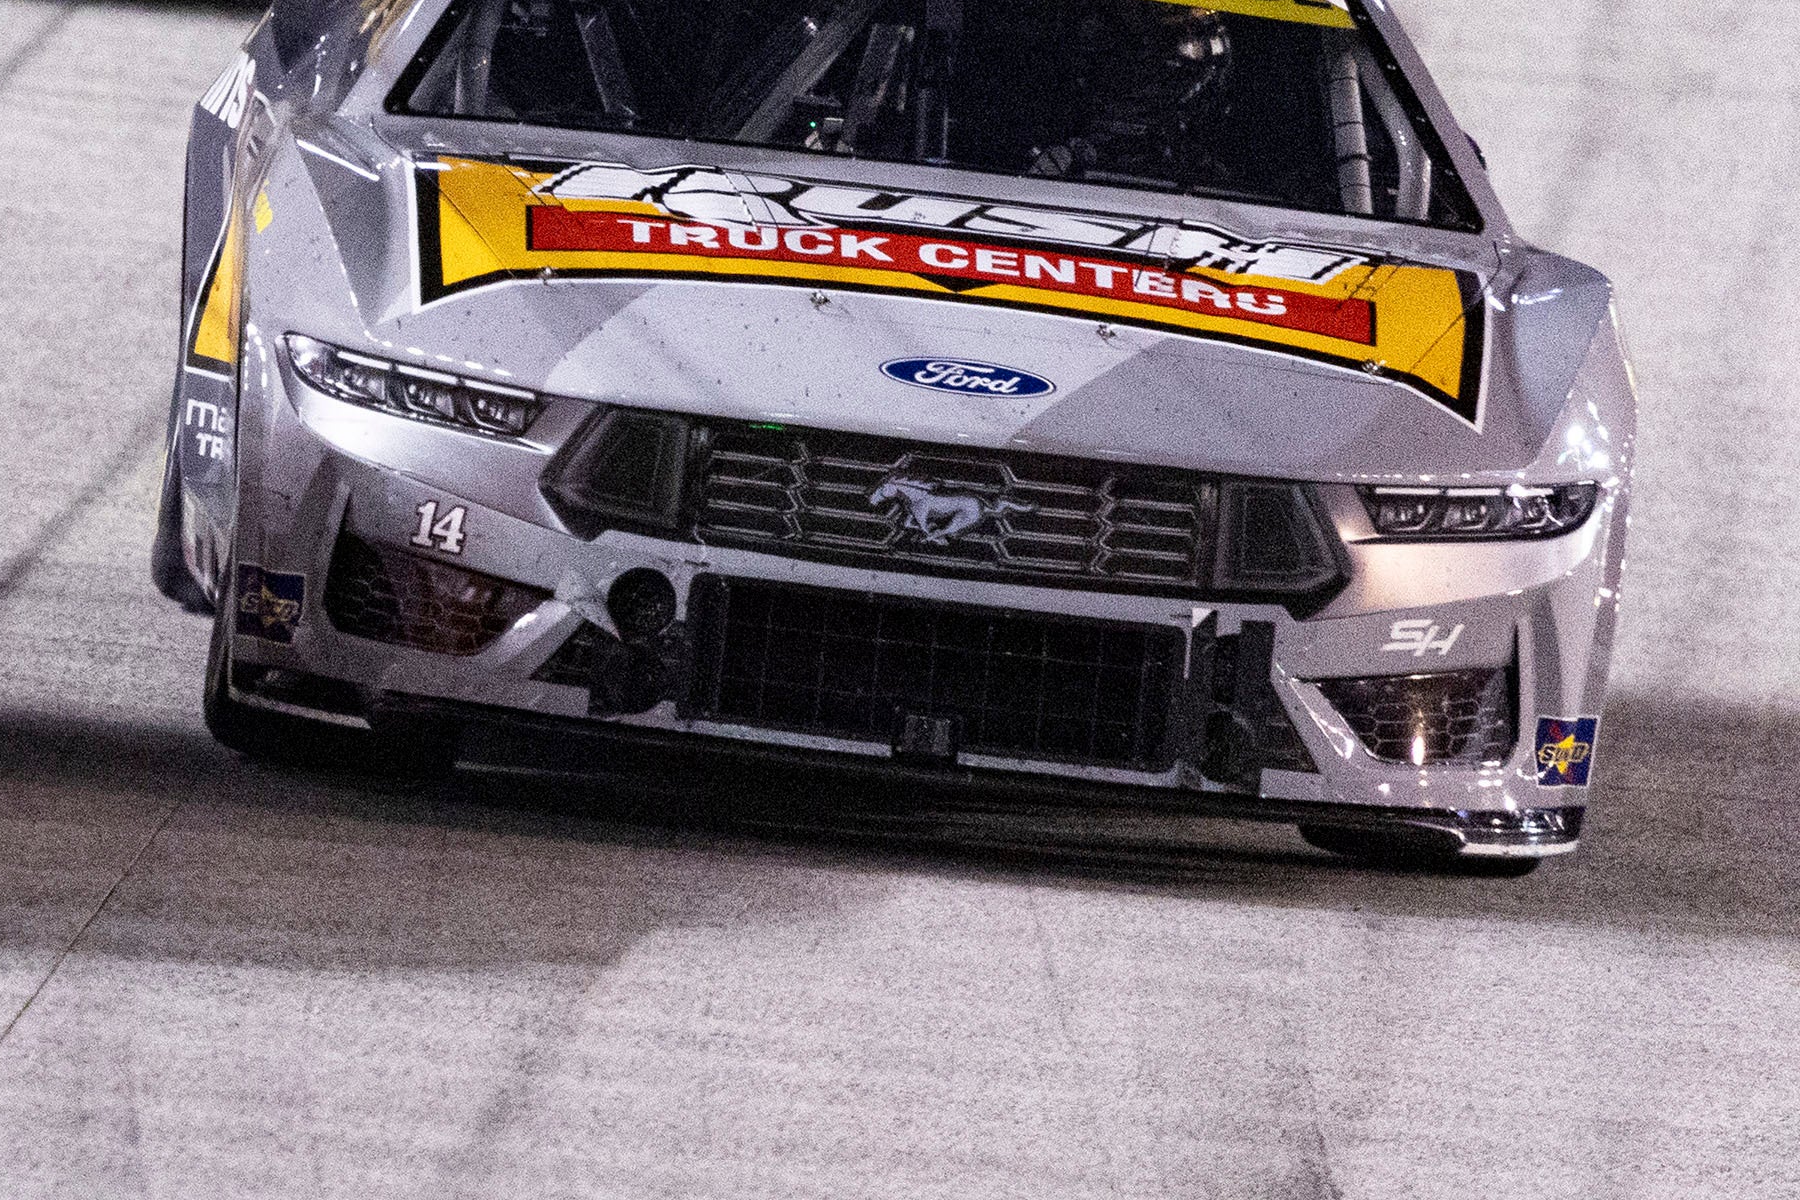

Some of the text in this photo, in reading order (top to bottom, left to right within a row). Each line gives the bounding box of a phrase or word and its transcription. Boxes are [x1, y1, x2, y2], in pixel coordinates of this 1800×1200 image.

[616, 219, 1288, 317] TRUCK CENTERS
[914, 360, 1024, 396] Ford
[411, 500, 468, 554] 14
